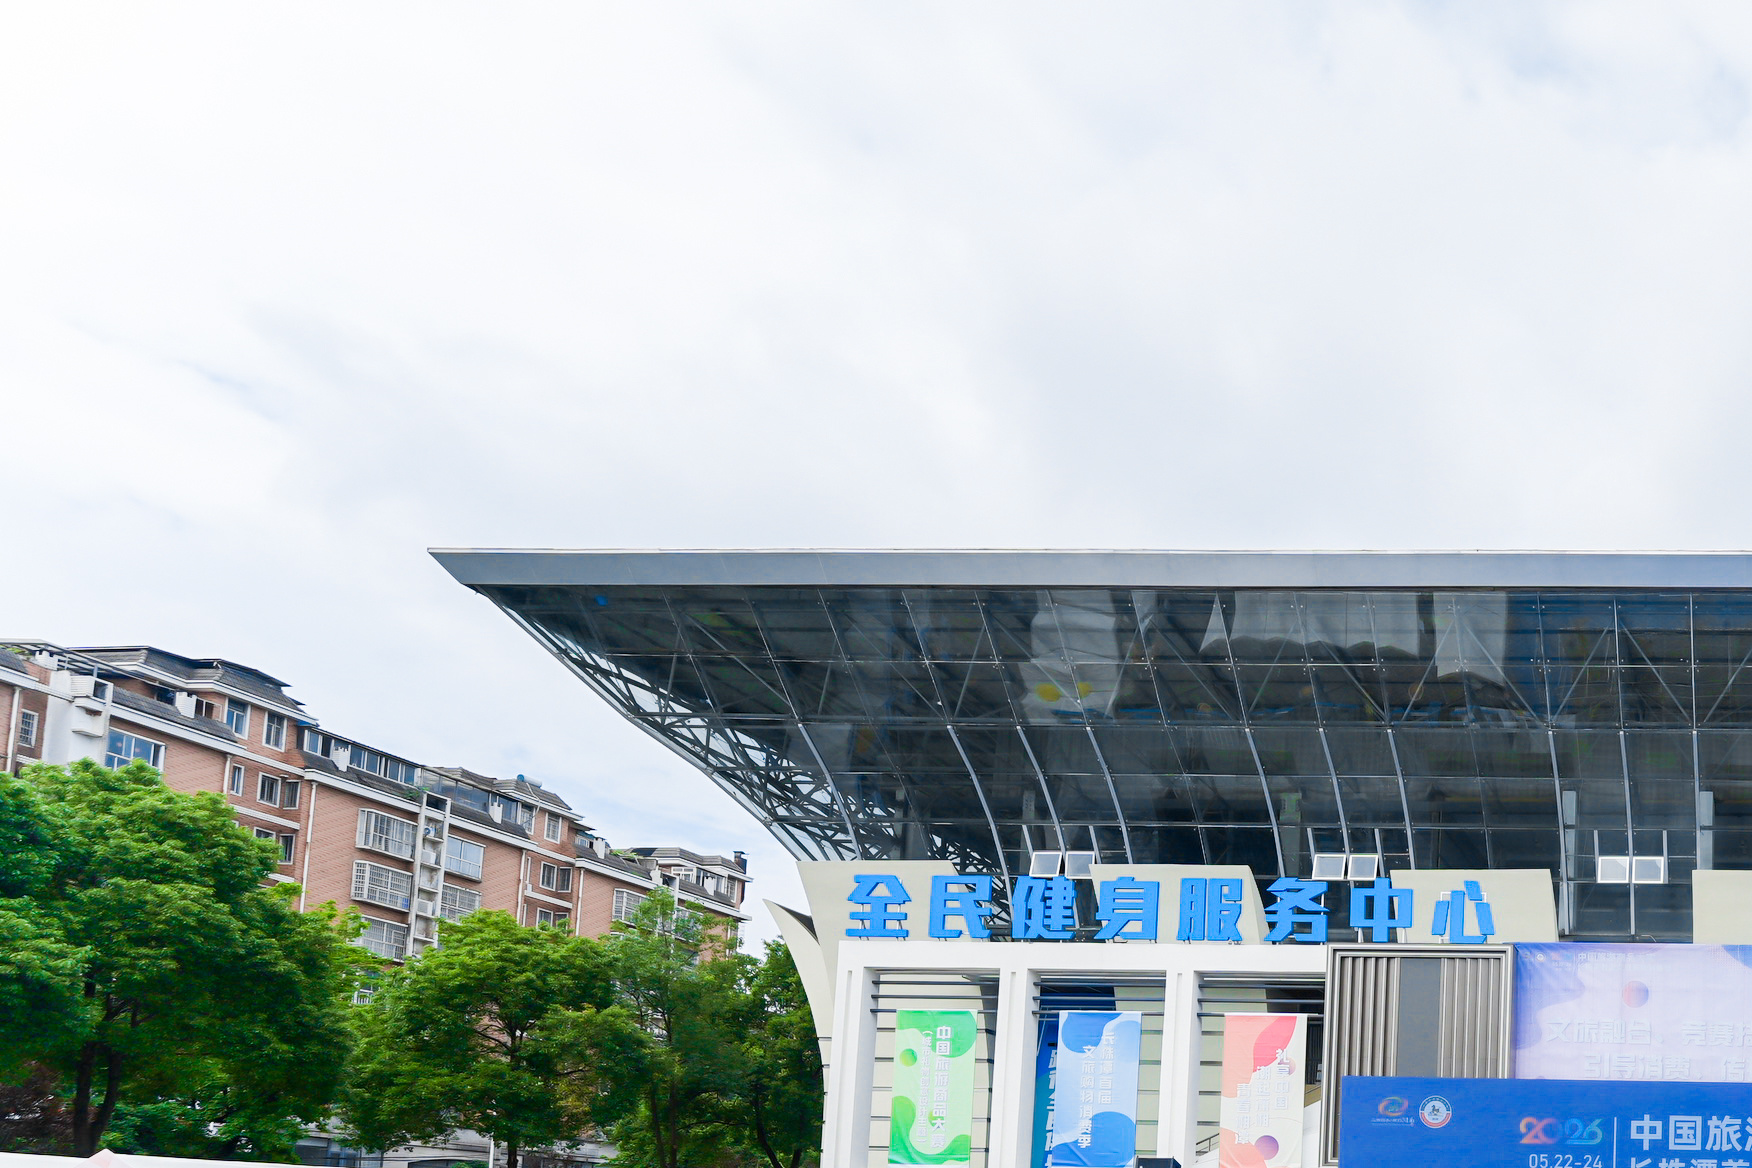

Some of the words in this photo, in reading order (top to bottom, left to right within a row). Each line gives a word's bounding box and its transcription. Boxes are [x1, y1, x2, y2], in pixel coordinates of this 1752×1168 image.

[845, 873, 1495, 944] 全民健身服务中心
[930, 1025, 953, 1149] 中国旅游商品大赛
[1077, 1044, 1097, 1149] 文旅购物消费季
[1098, 1031, 1117, 1105] 长株潭首届
[1519, 1116, 1604, 1145] 2026
